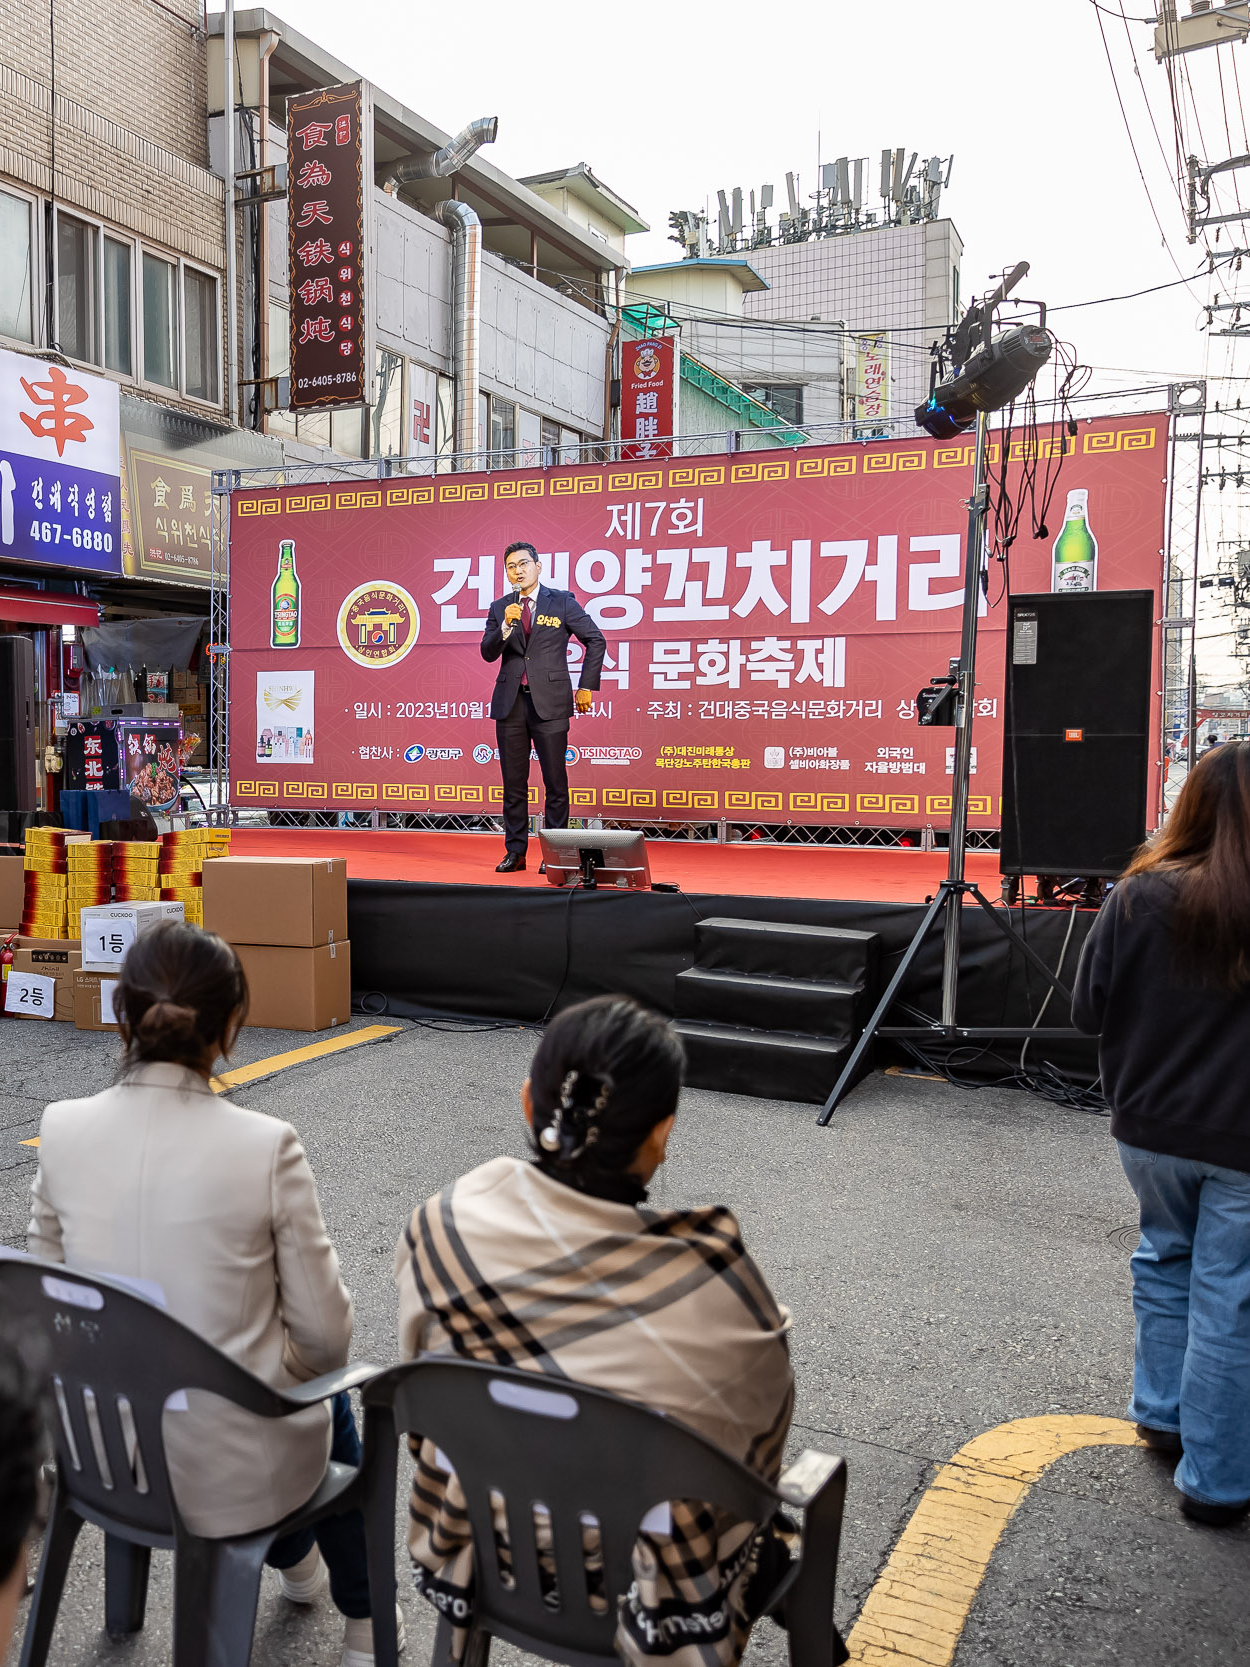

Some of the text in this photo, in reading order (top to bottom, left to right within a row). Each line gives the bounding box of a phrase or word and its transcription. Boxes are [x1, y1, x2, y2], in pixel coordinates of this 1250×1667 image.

[338, 242, 353, 356] 식위천식당
[298, 371, 357, 389] 02-6405-8786
[631, 380, 664, 390] Fried Food
[30, 477, 113, 523] 건대직영점
[605, 497, 704, 540] 제7회
[30, 520, 113, 553] 467-6880
[649, 636, 847, 690] 문화축제
[353, 702, 383, 720] 일시
[647, 701, 681, 720] 주최
[698, 698, 883, 720] 건대중국음식문화거리
[359, 744, 394, 760] 협찬사
[426, 747, 464, 761] 광진구
[580, 747, 642, 759] TSINGTAO
[660, 745, 735, 757] (주)대진미래통상
[876, 746, 914, 760] 외국인
[864, 761, 926, 775] 자율방범대
[166, 906, 184, 915] CUCKOO
[99, 933, 125, 954] 1등
[19, 987, 45, 1007] 2등
